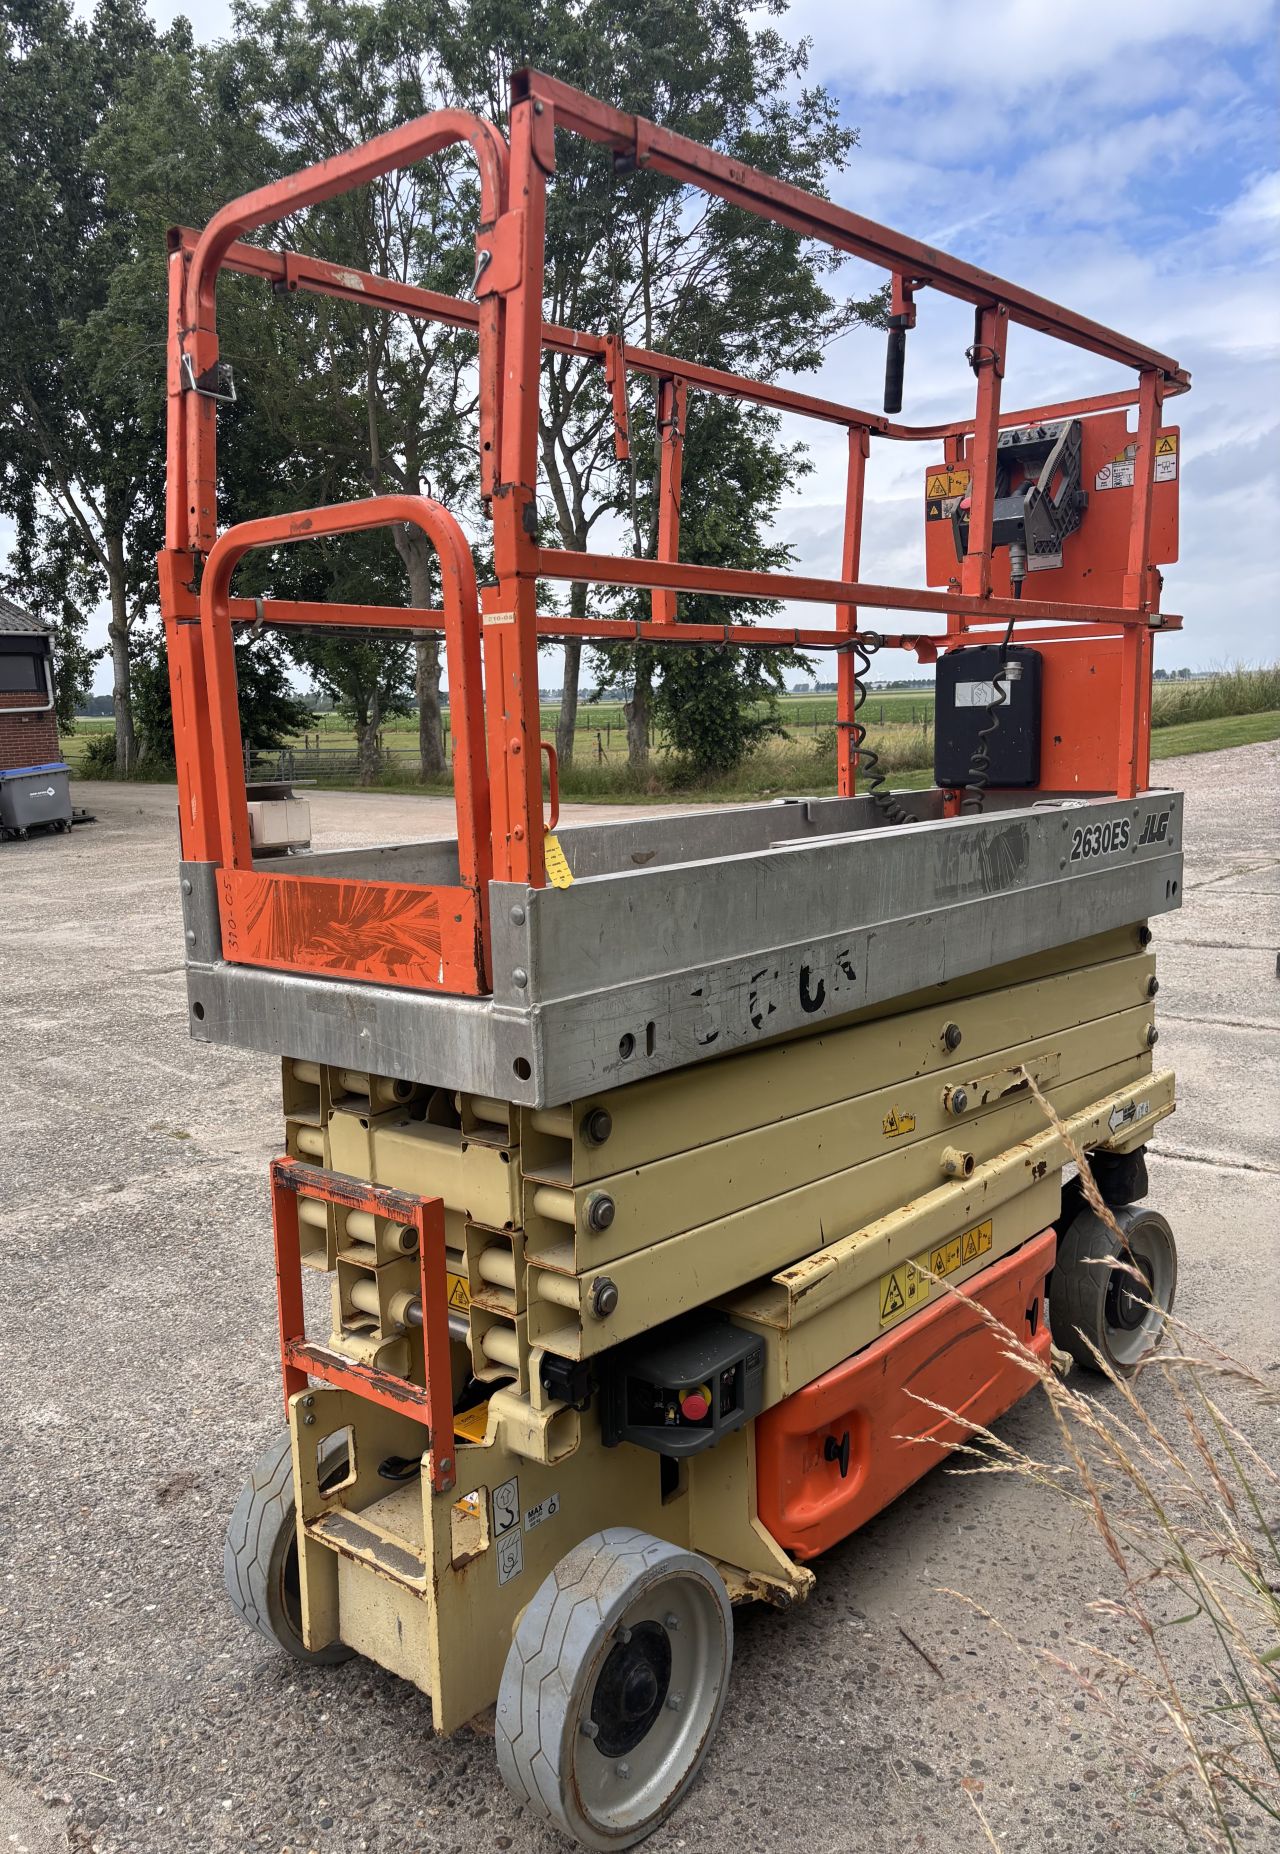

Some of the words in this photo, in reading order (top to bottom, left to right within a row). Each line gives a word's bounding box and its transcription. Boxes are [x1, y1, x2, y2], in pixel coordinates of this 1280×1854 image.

[1070, 818, 1131, 862] 2630ES
[1138, 811, 1170, 846] JLG
[528, 1503, 543, 1518] MAX
